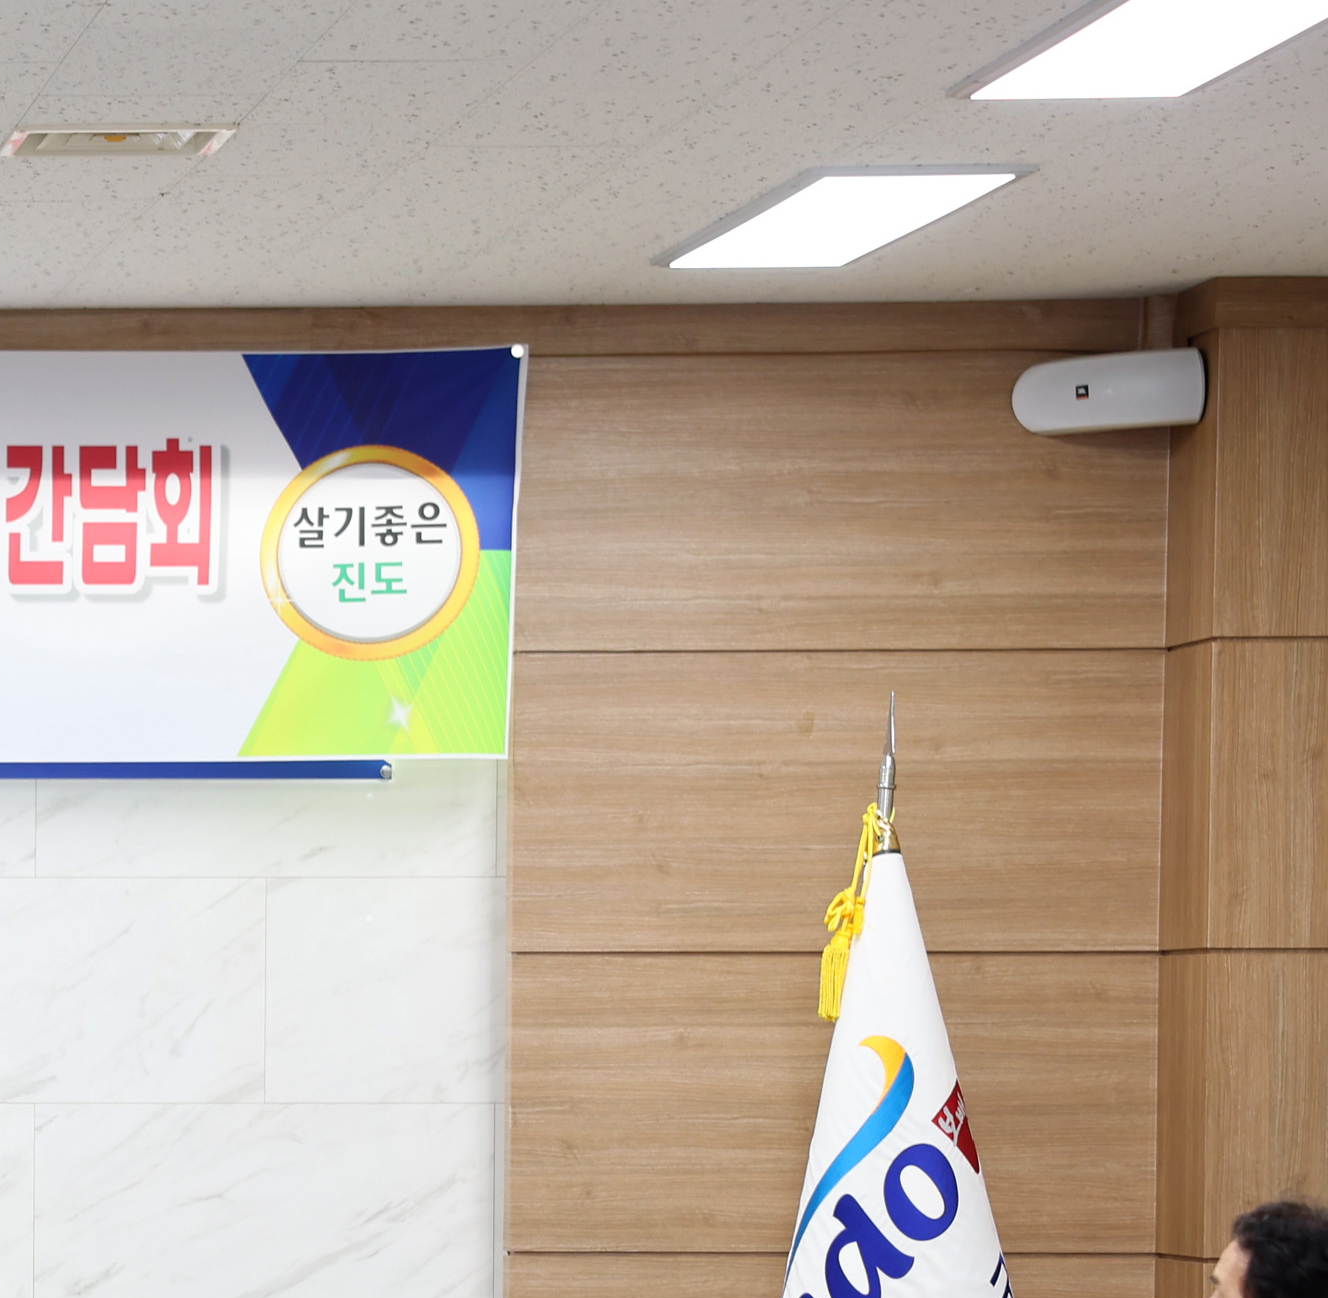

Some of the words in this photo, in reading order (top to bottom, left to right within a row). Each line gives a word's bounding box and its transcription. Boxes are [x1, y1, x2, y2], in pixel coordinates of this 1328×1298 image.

[5, 437, 213, 586] 간담회
[293, 501, 448, 549] 살기좋은
[331, 561, 408, 604] 진도
